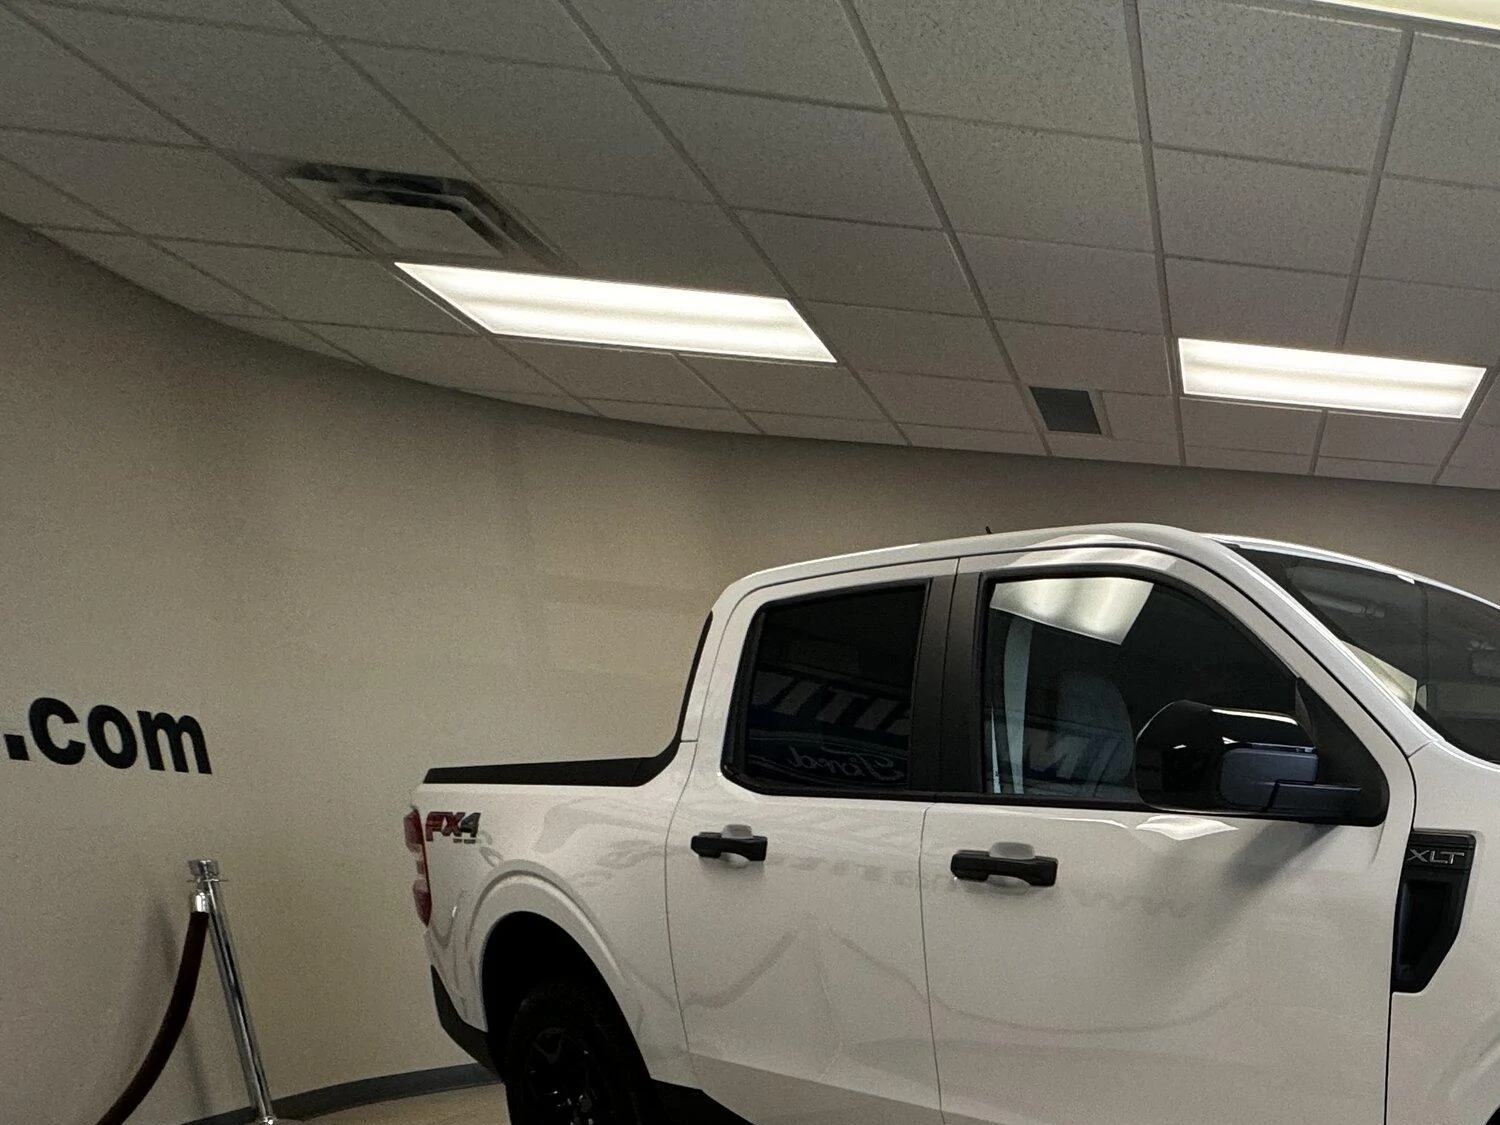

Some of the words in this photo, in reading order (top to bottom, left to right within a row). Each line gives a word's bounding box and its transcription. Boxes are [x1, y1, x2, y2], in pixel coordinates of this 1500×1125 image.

[3, 697, 213, 775] .com
[425, 811, 481, 841] FX4
[1407, 848, 1465, 865] XLT
